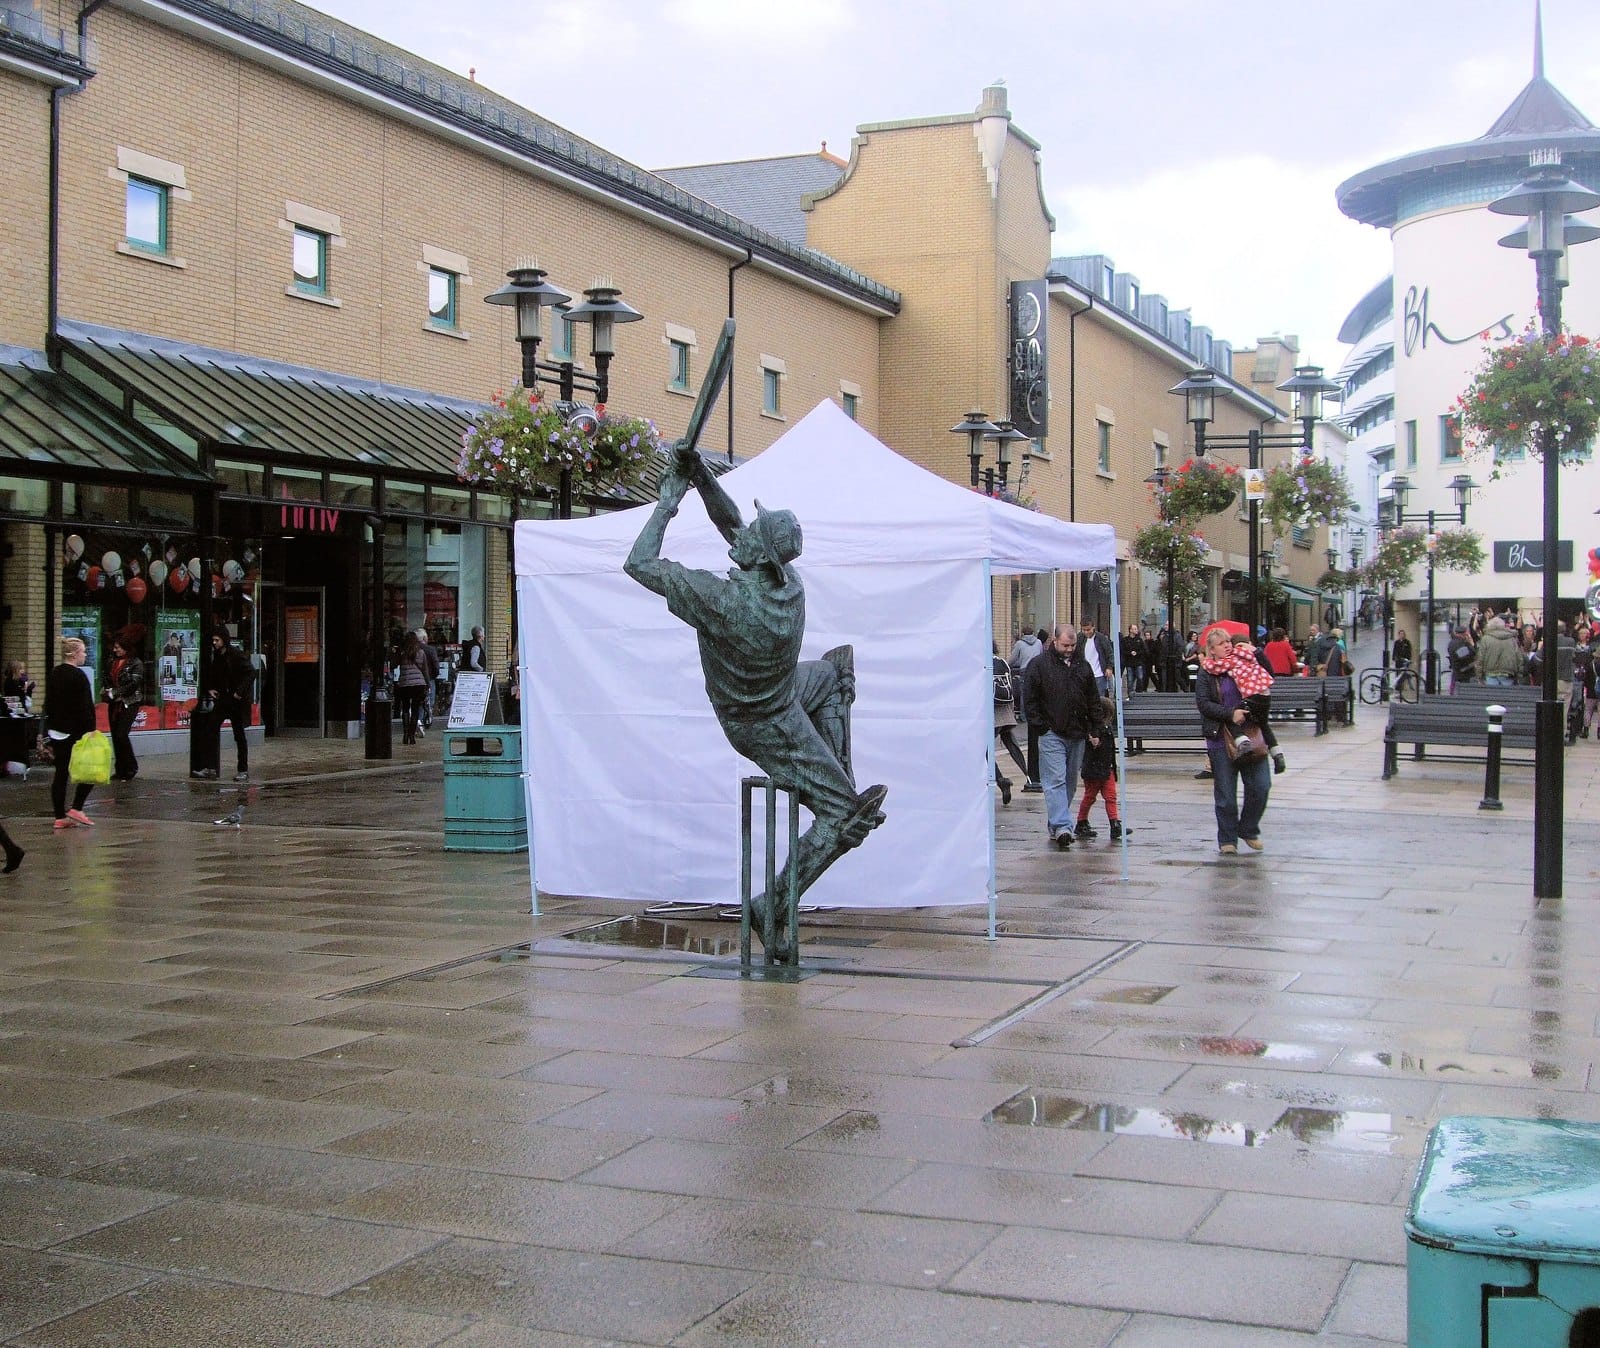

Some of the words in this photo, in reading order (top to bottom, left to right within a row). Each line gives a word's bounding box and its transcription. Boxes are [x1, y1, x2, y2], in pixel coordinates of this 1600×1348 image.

[1404, 285, 1514, 356] Bhs
[1014, 338, 1025, 381] look
[281, 481, 339, 533] hmv
[1508, 543, 1545, 568] Bh
